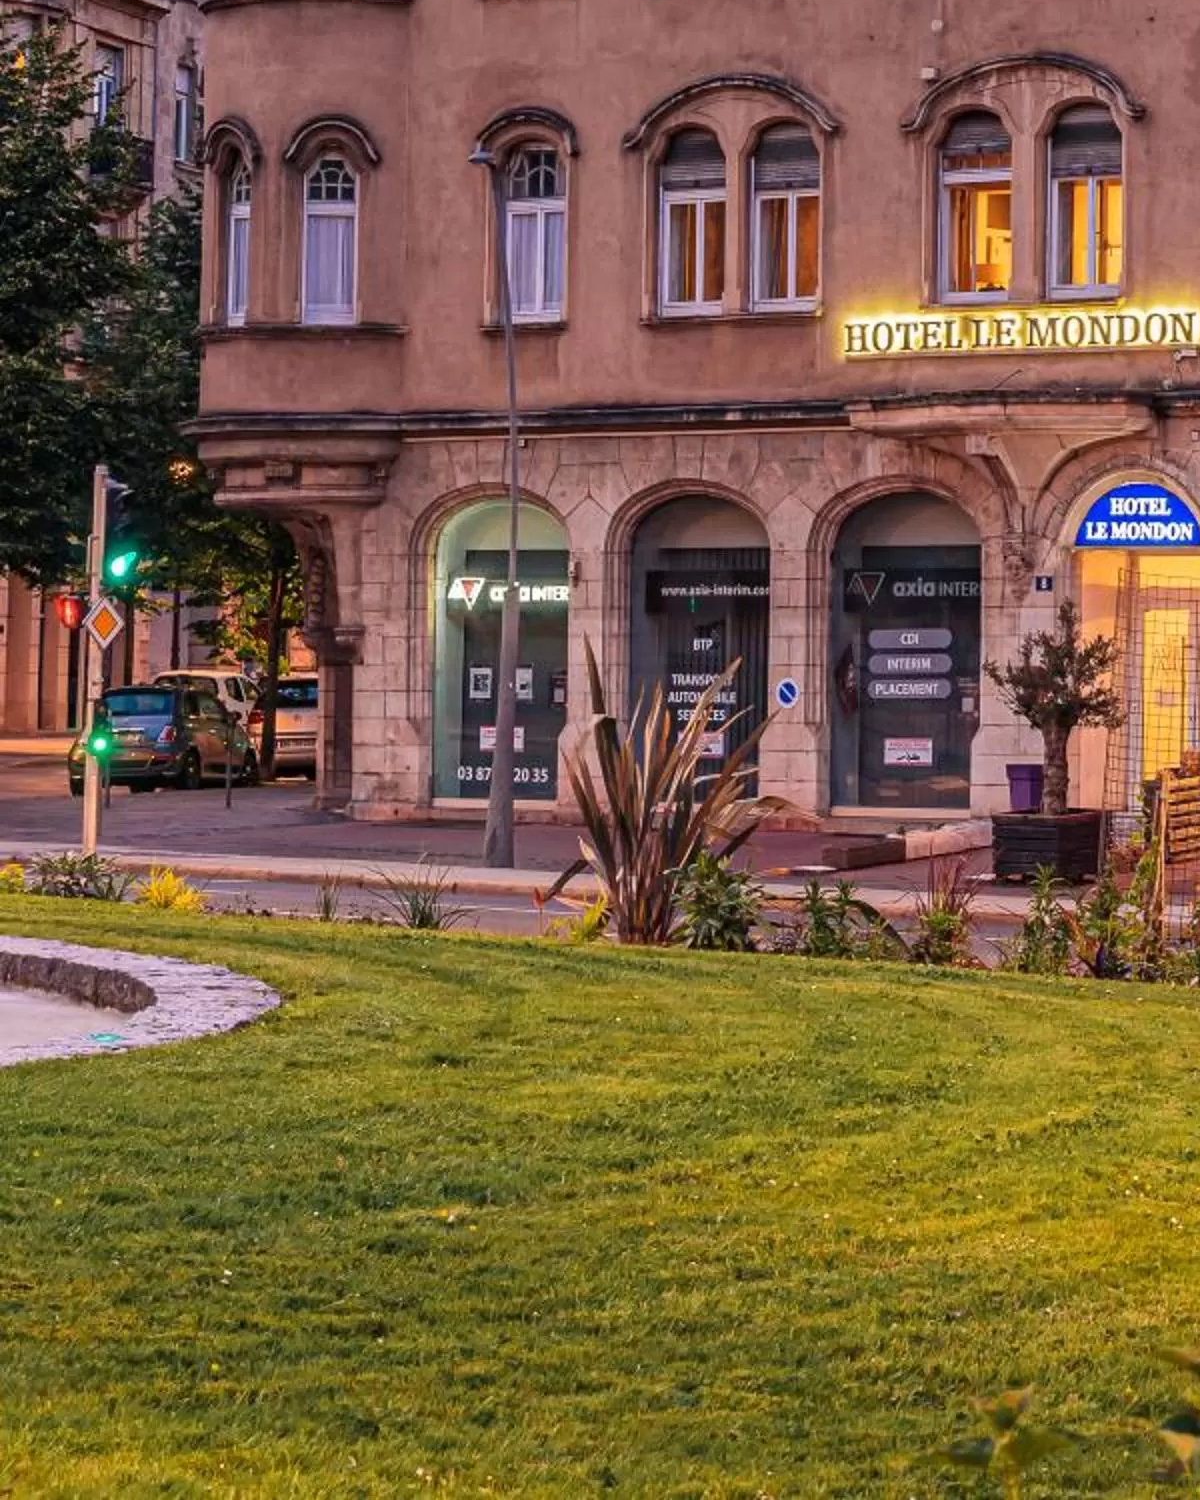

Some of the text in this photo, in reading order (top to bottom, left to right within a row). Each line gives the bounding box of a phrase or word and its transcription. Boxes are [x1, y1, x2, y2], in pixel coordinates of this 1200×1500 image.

[845, 312, 1197, 353] HOTEL LE MONDON
[1109, 496, 1171, 516] HOTEL
[1085, 521, 1194, 541] LE MONDON
[893, 576, 935, 597] axia
[693, 638, 713, 651] BTP
[901, 633, 919, 645] CDI
[875, 683, 939, 696] PLACEMENT
[457, 766, 549, 783] 03 87 20 35
